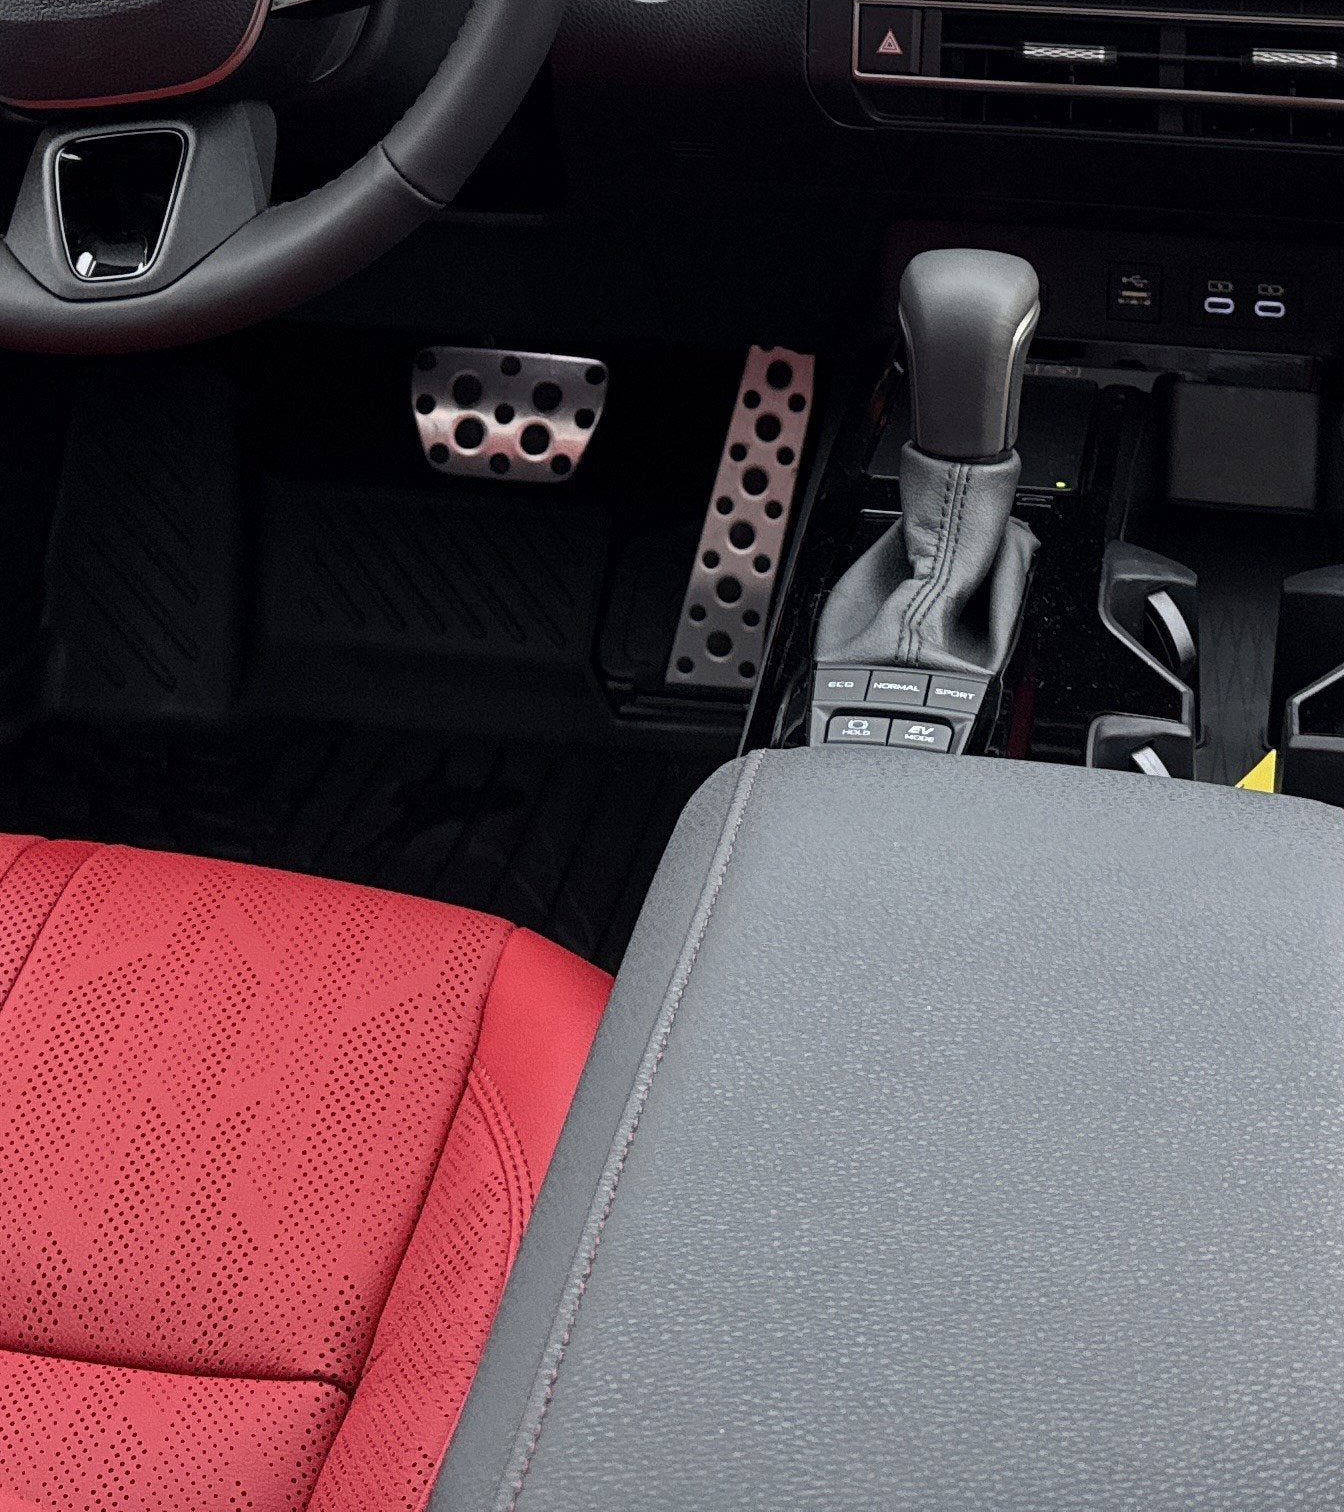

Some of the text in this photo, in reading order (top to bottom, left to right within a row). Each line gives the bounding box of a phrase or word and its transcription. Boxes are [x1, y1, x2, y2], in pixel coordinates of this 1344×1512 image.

[827, 680, 854, 689] ECO
[873, 681, 921, 693] NORMAL
[935, 688, 976, 699] SPORT
[842, 728, 871, 737] HOLD
[908, 725, 935, 734] EV
[904, 733, 935, 744] MODE
